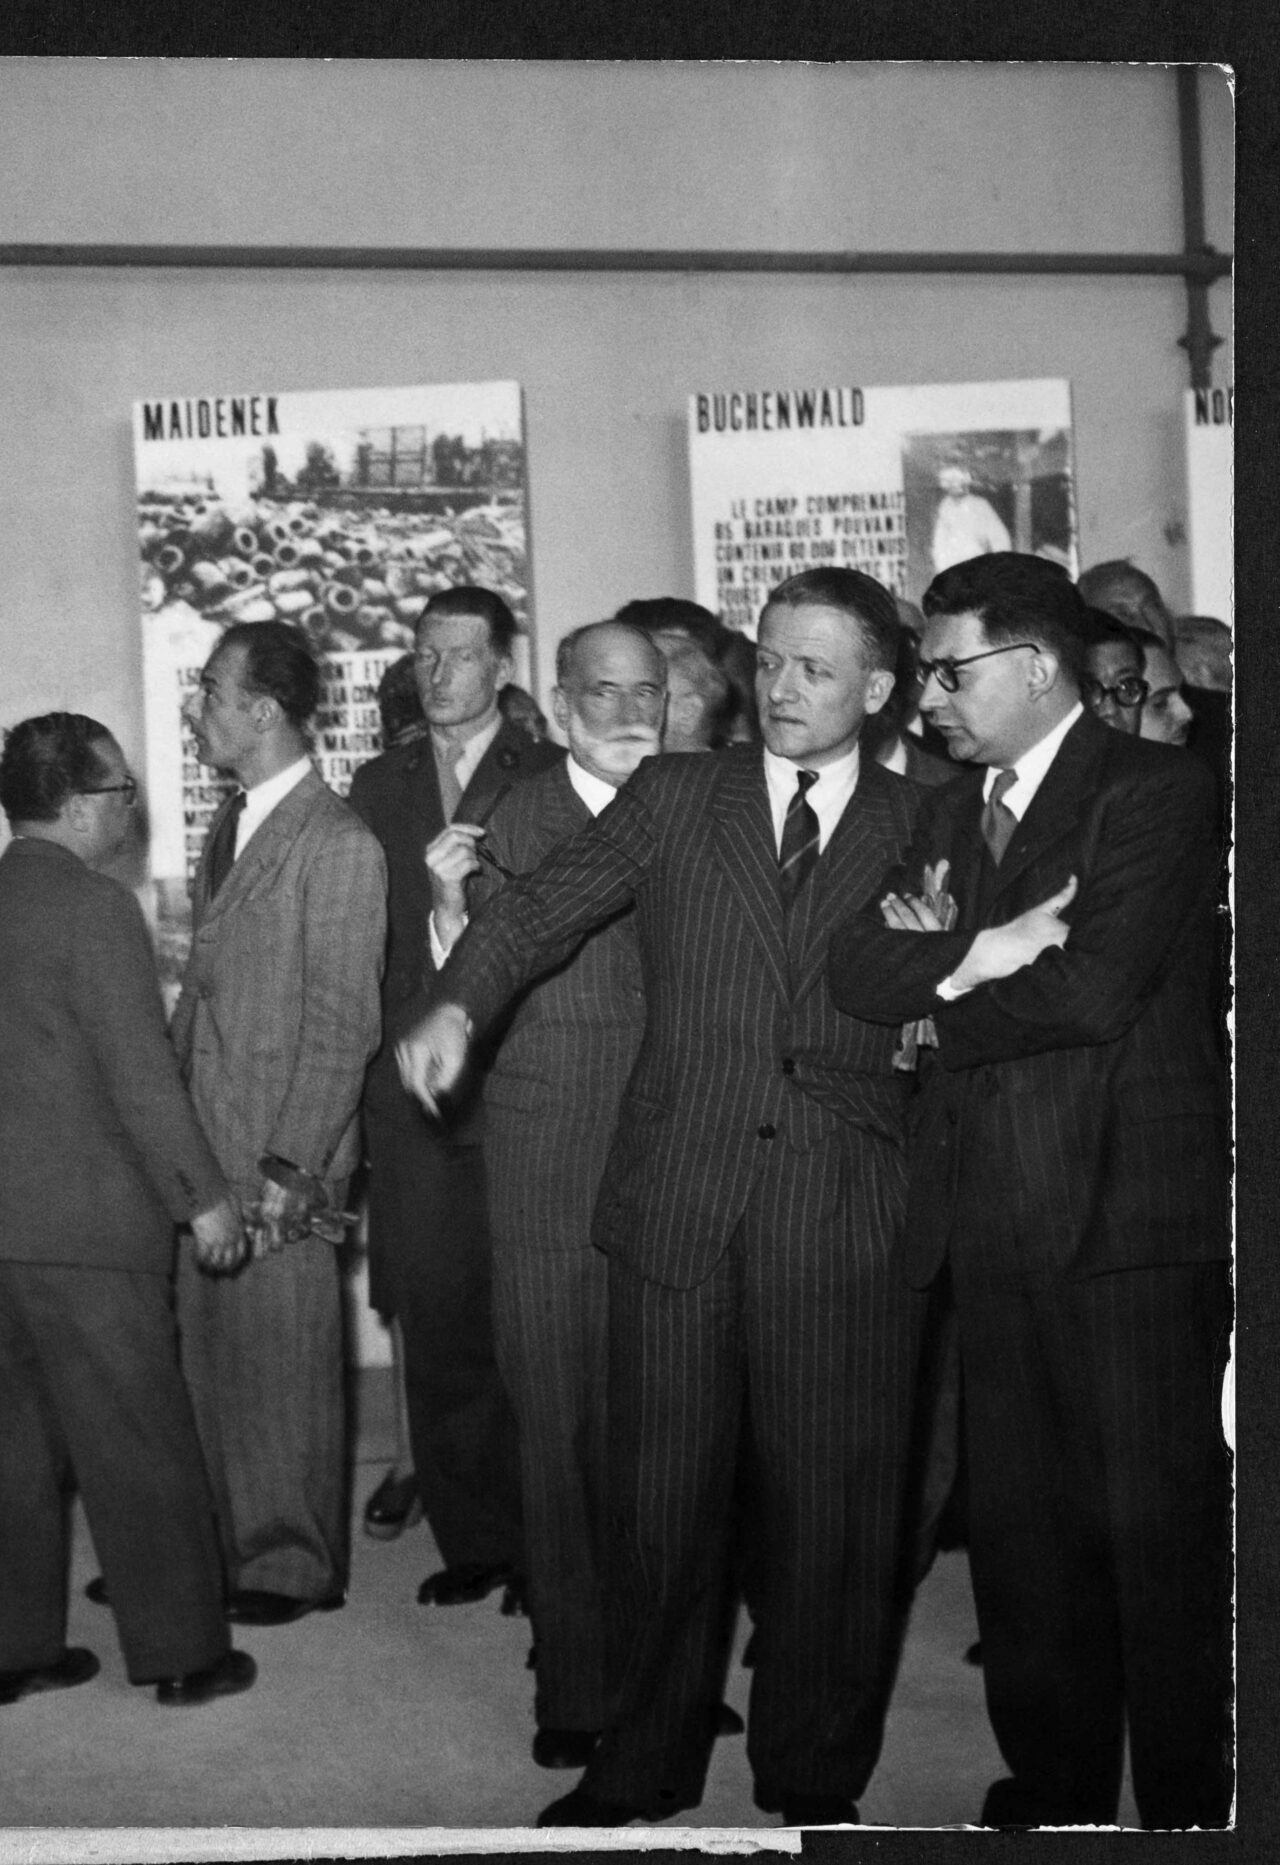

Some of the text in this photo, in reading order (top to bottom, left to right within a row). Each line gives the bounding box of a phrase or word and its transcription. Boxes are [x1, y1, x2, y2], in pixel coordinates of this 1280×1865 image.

[143, 397, 279, 440] MAIDENEK
[697, 387, 864, 433] BUCHENWALD
[1196, 388, 1234, 426] NO
